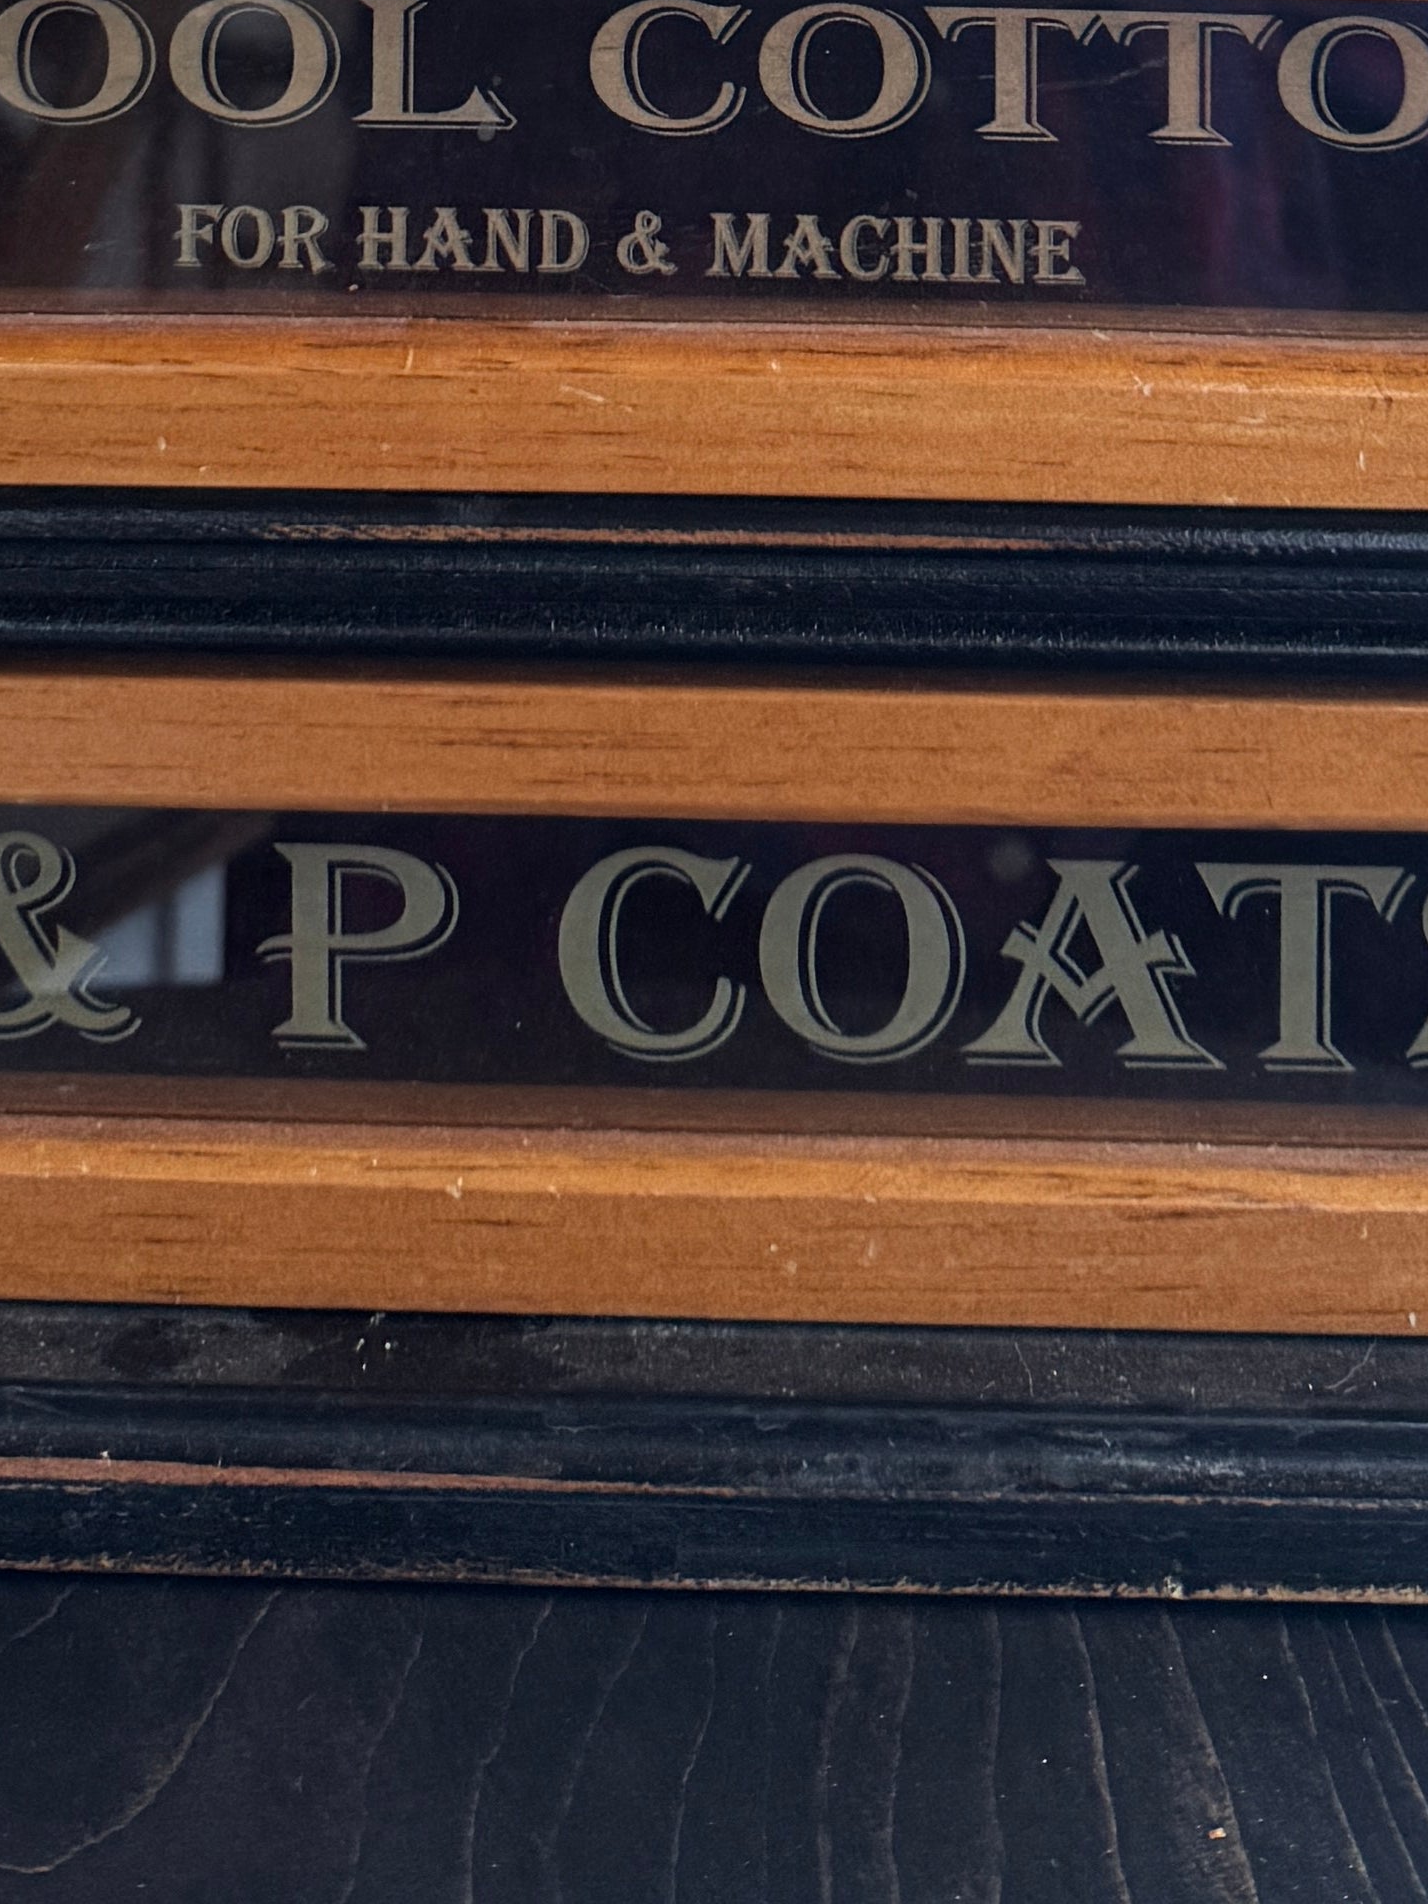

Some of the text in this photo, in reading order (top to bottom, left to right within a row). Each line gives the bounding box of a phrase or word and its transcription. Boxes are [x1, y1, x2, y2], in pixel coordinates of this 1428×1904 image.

[173, 202, 1086, 285] FOR HAND & MACHINE
[255, 841, 460, 1050] P
